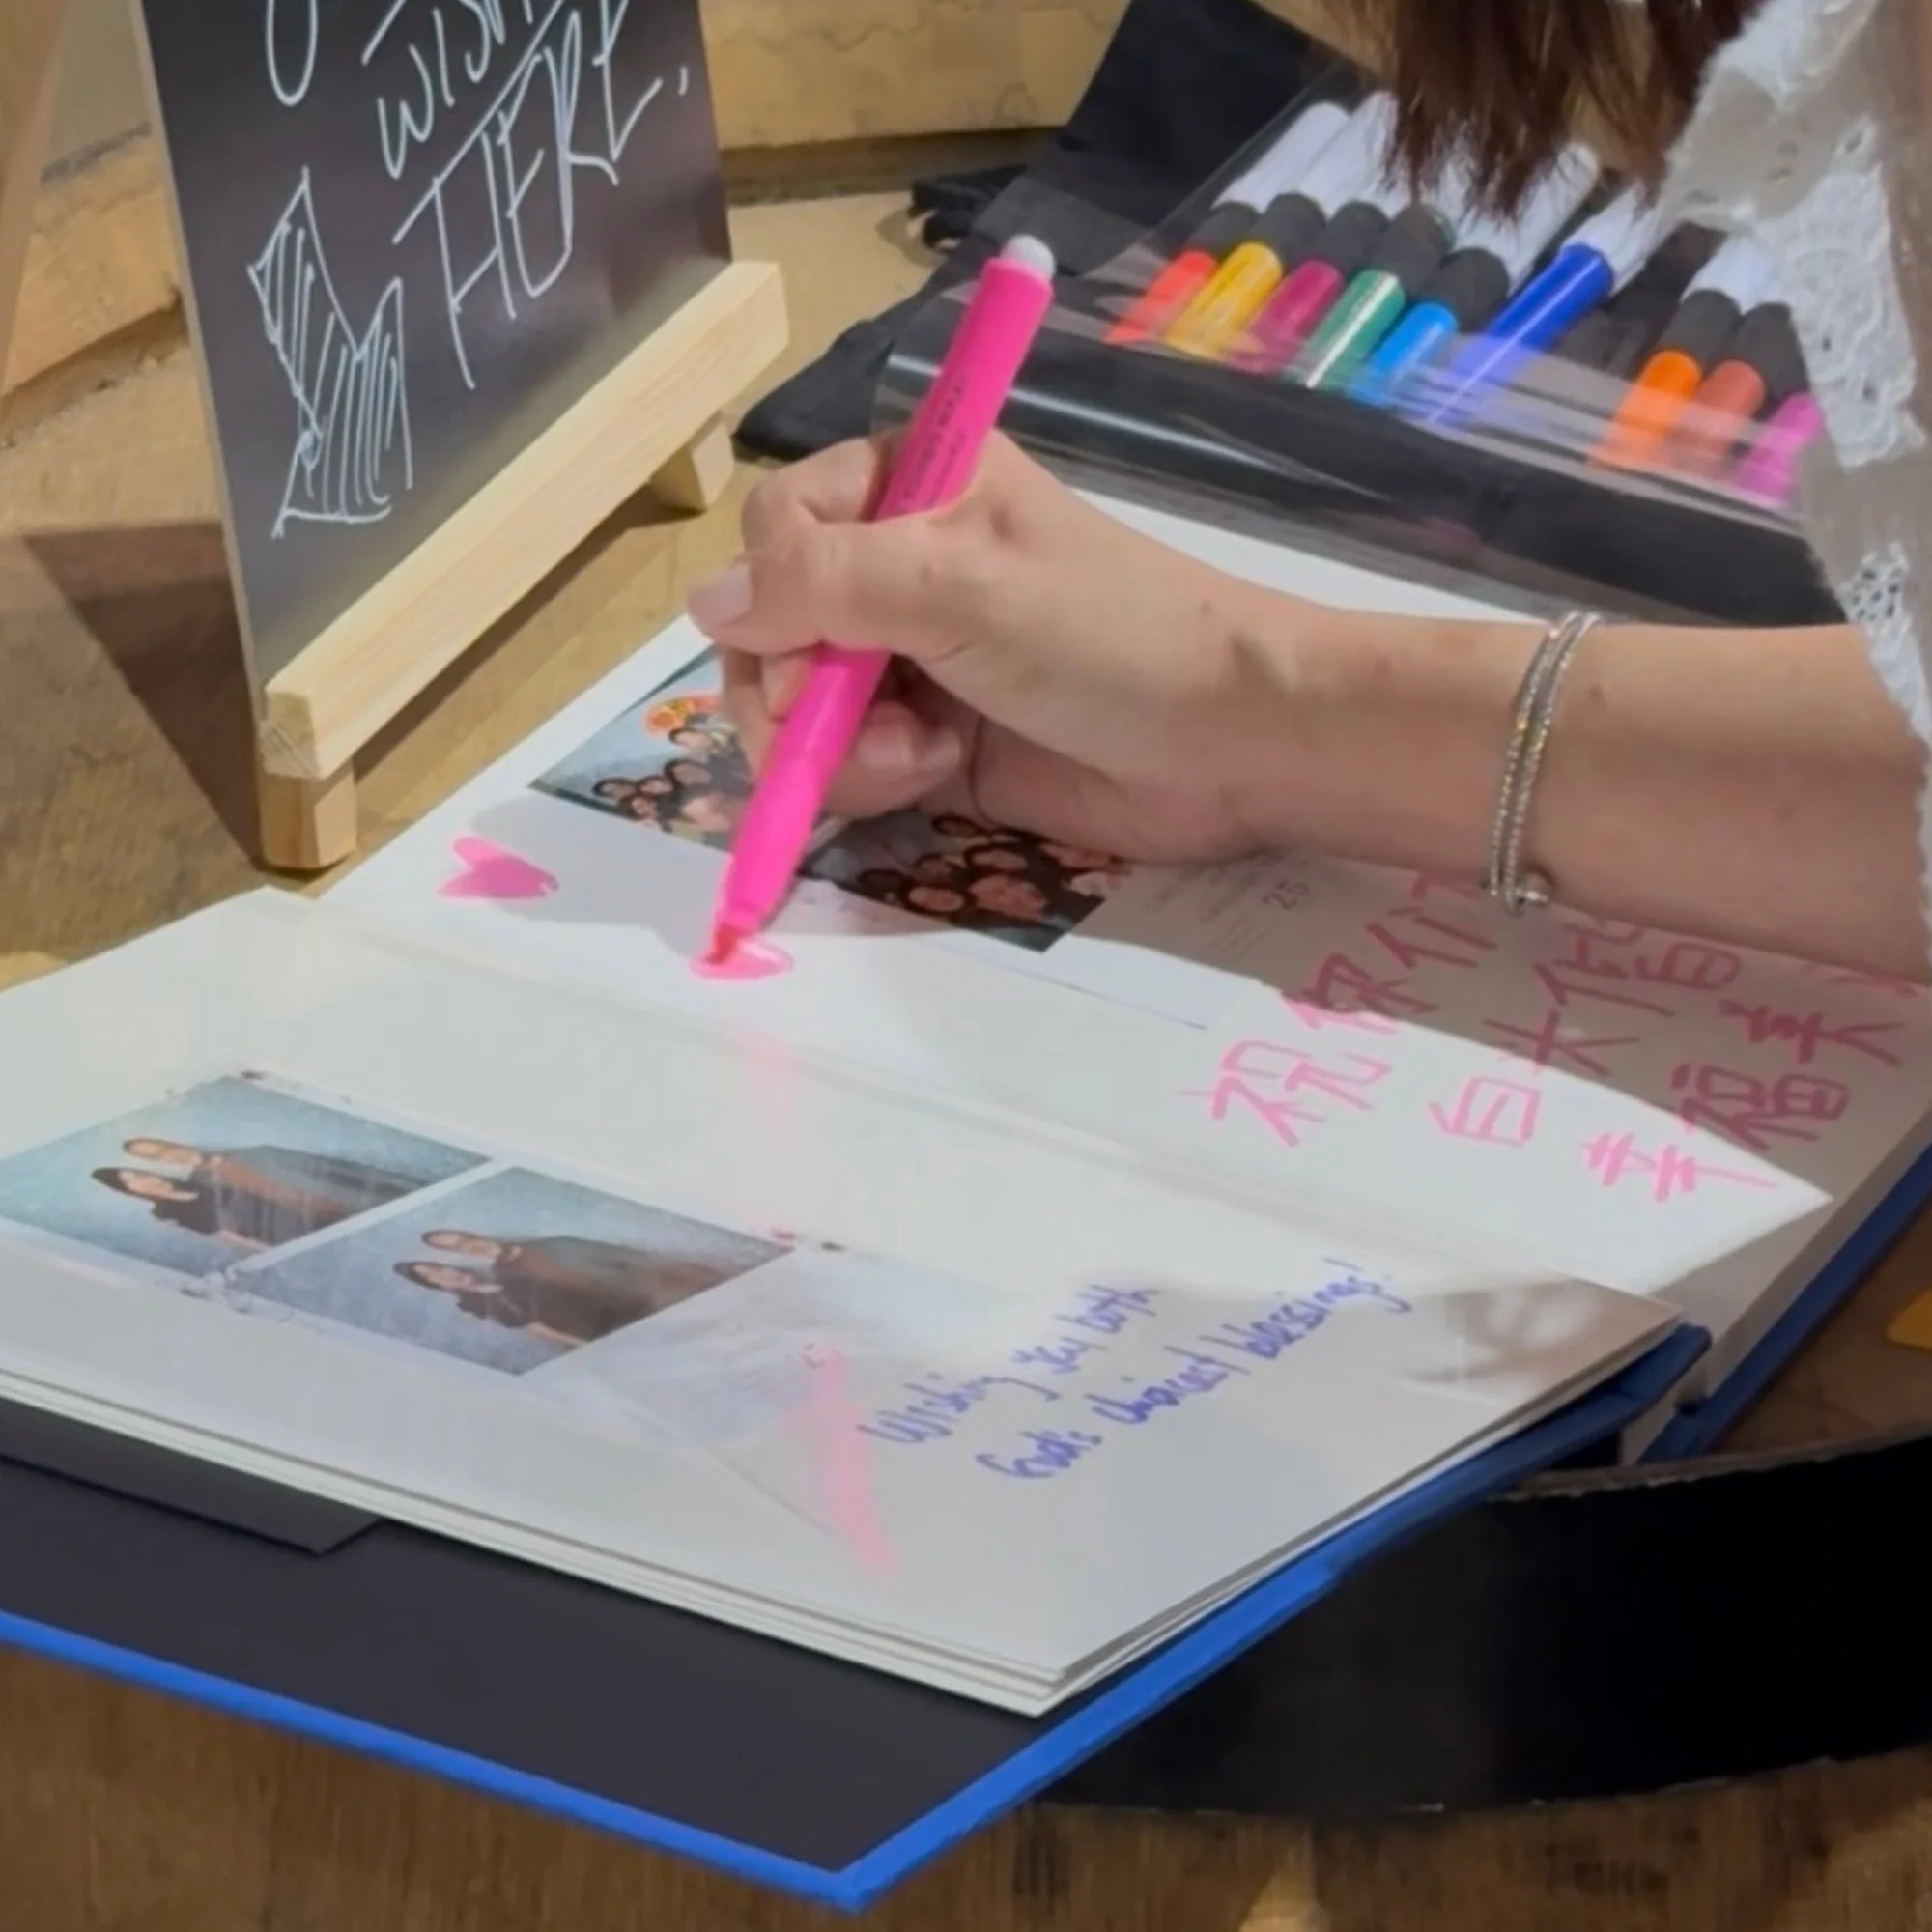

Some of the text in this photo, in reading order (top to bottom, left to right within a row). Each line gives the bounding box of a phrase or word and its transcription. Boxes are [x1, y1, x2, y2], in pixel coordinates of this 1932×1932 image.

[1581, 976, 1918, 1204] 幸福美
[855, 1283, 1162, 1443] Wishing you both
[975, 1429, 1103, 1479] God's
